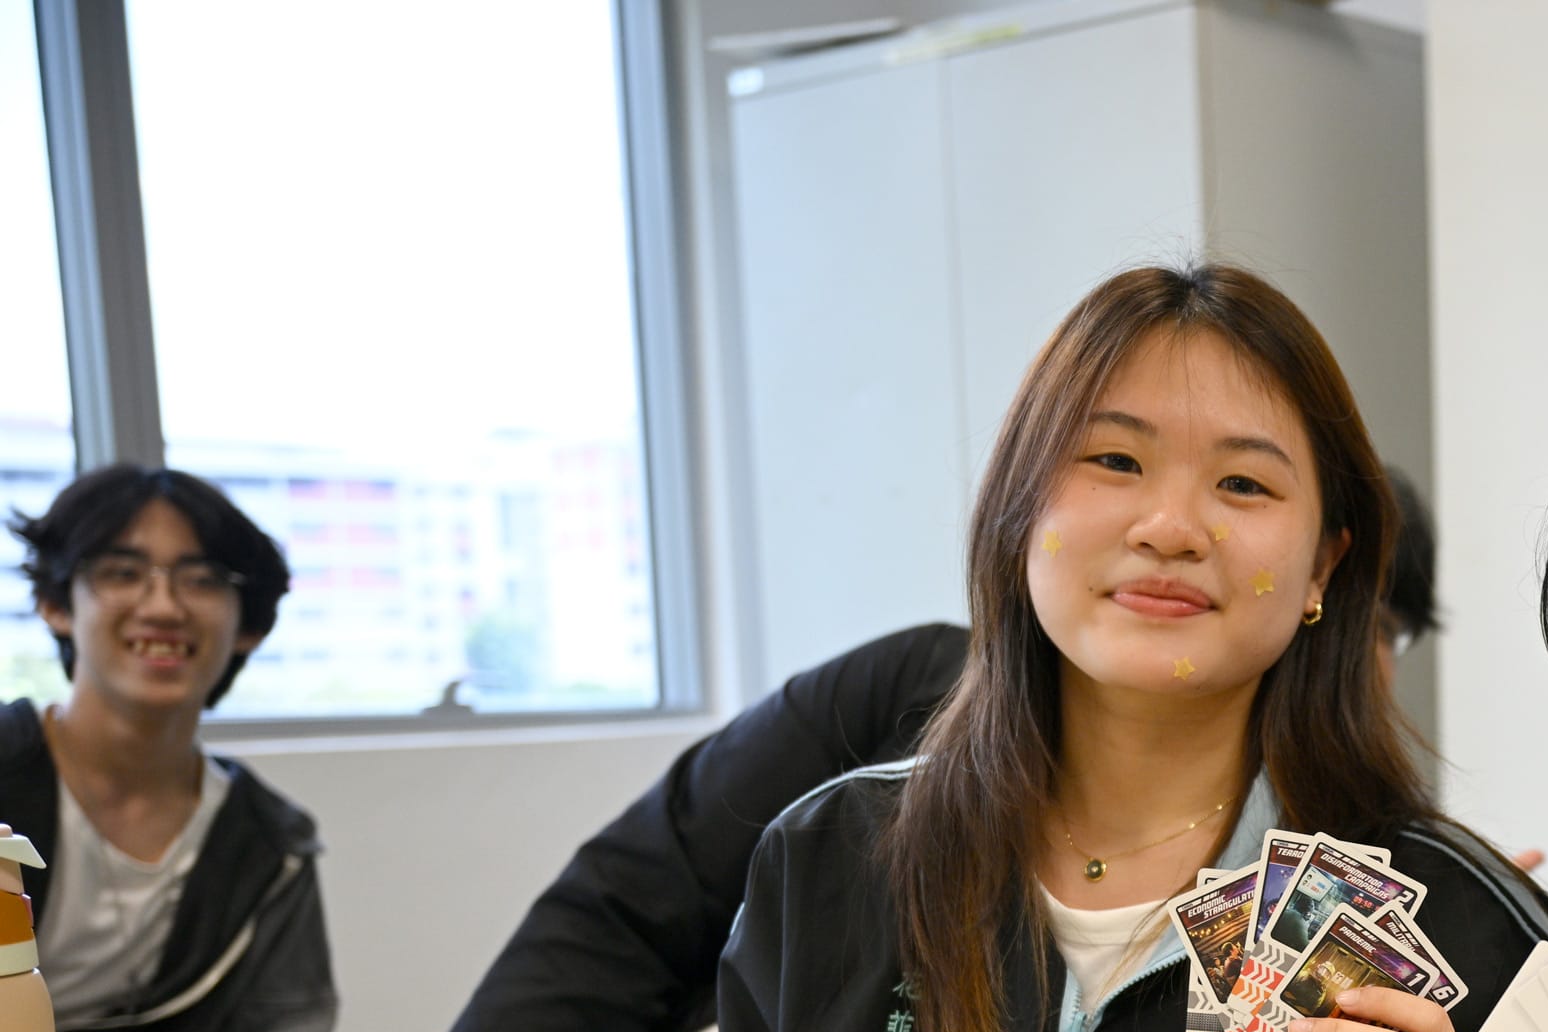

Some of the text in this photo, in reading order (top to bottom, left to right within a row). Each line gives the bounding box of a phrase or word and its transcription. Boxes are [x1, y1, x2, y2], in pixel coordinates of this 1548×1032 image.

[1277, 847, 1305, 858] TERRO
[1320, 852, 1384, 887] DISINFORMATION
[1344, 874, 1389, 899] CAMPAIGNS
[1187, 894, 1227, 918] ECONOMIC
[1203, 890, 1254, 919] STRANGULATI
[1338, 926, 1377, 953] PANDEMIC
[1407, 973, 1427, 987] 1
[1432, 985, 1456, 1000] 6
